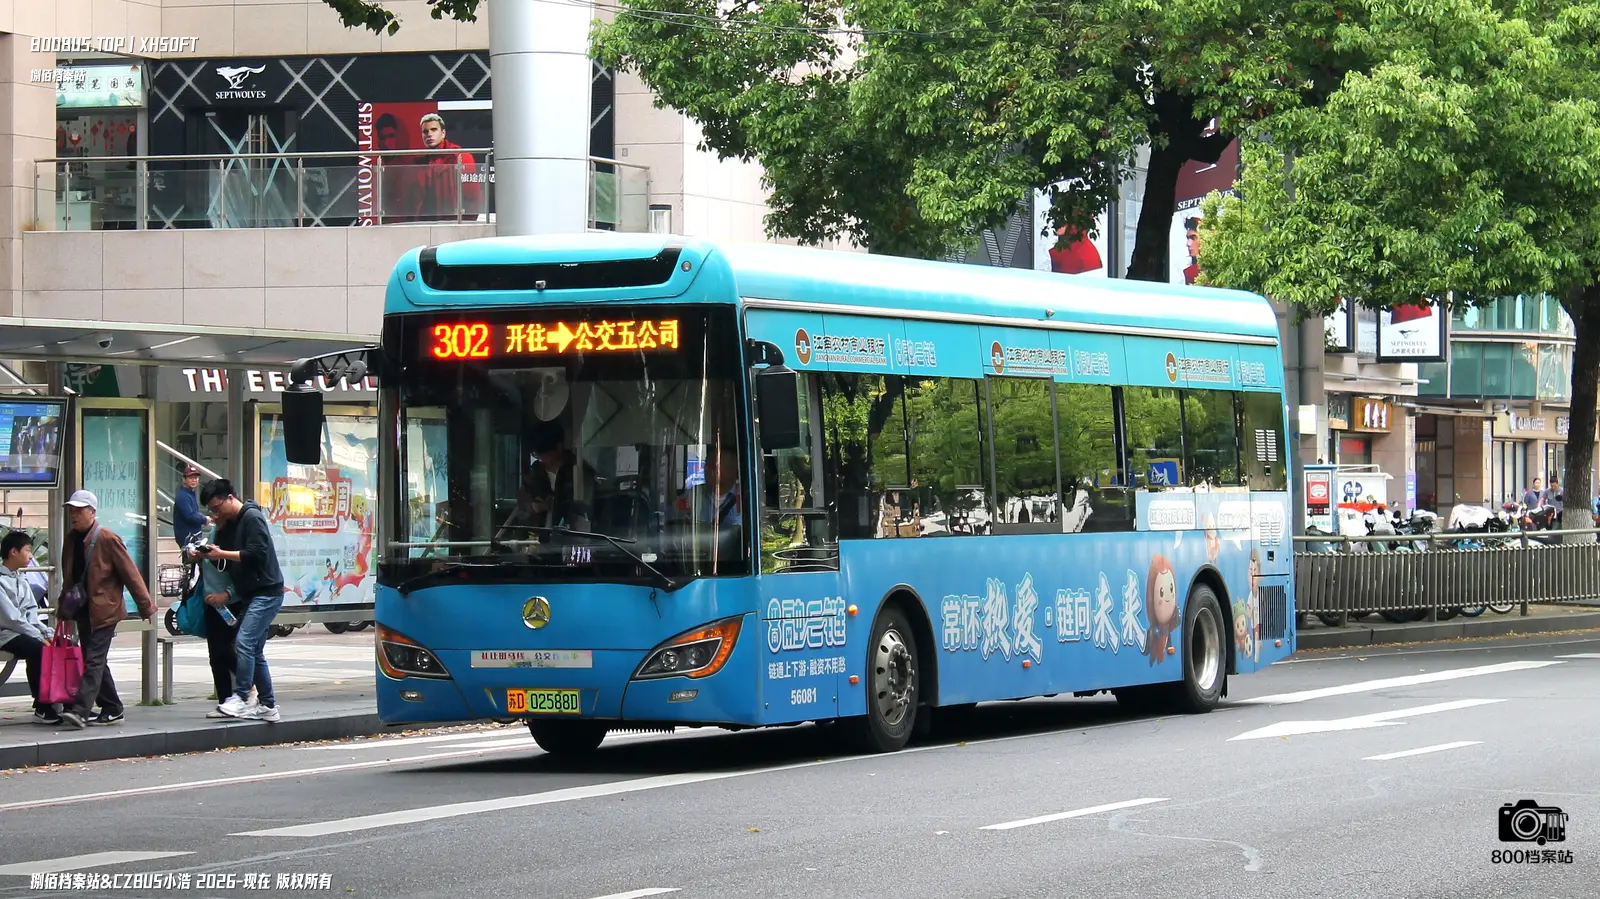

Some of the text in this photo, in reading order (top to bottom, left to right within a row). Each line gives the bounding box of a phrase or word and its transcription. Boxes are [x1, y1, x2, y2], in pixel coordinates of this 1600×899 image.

[215, 90, 267, 99] SEPTWOLVES
[433, 323, 491, 358] 302
[505, 319, 679, 353] 开往 公交五公司
[530, 693, 578, 710] 02588D
[791, 687, 817, 705] 56081
